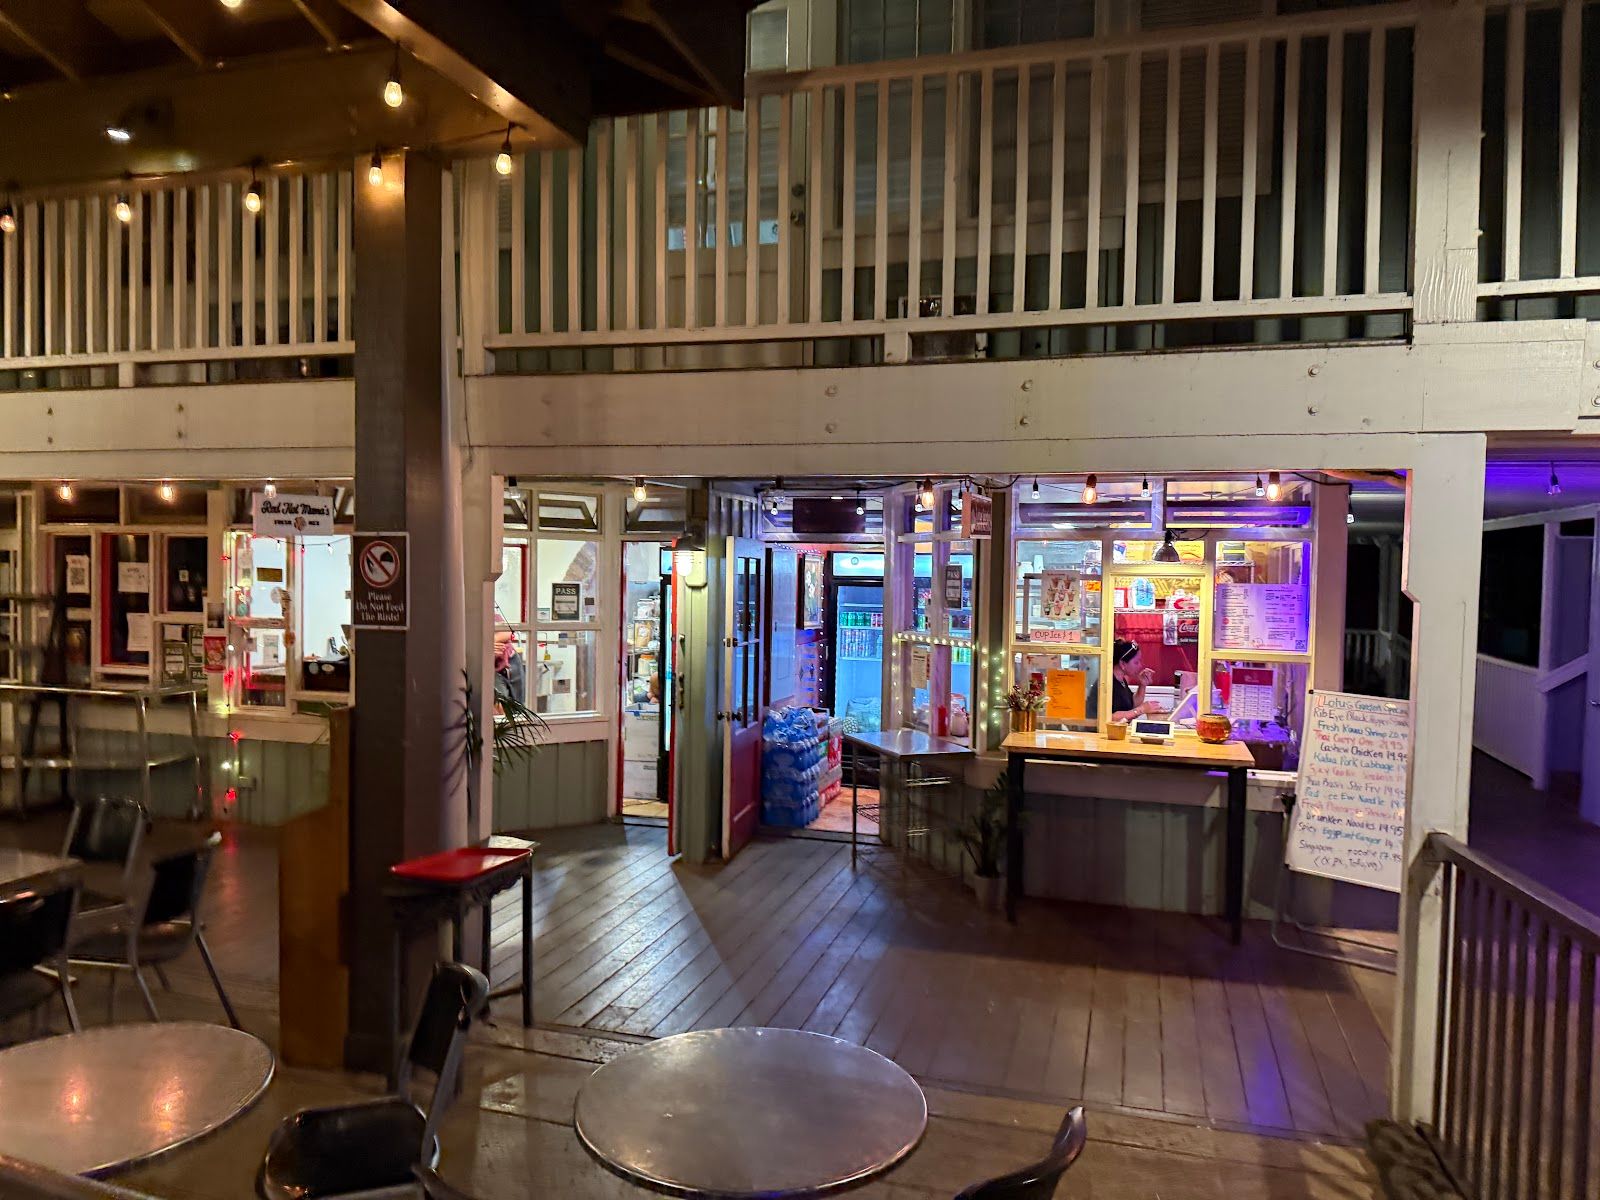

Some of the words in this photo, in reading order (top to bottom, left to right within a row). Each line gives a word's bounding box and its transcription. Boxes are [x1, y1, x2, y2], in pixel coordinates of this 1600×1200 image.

[261, 500, 281, 514] Red
[282, 502, 300, 514] Hot
[300, 503, 330, 516] Mama's
[368, 591, 392, 601] Please
[555, 587, 577, 595] PASS
[356, 601, 368, 610] Do
[370, 601, 384, 611] Not
[386, 601, 404, 612] Feed
[361, 611, 375, 621] The
[1034, 631, 1049, 640] CUP
[1318, 720, 1340, 732] Fresh
[1351, 745, 1383, 758] Chicken
